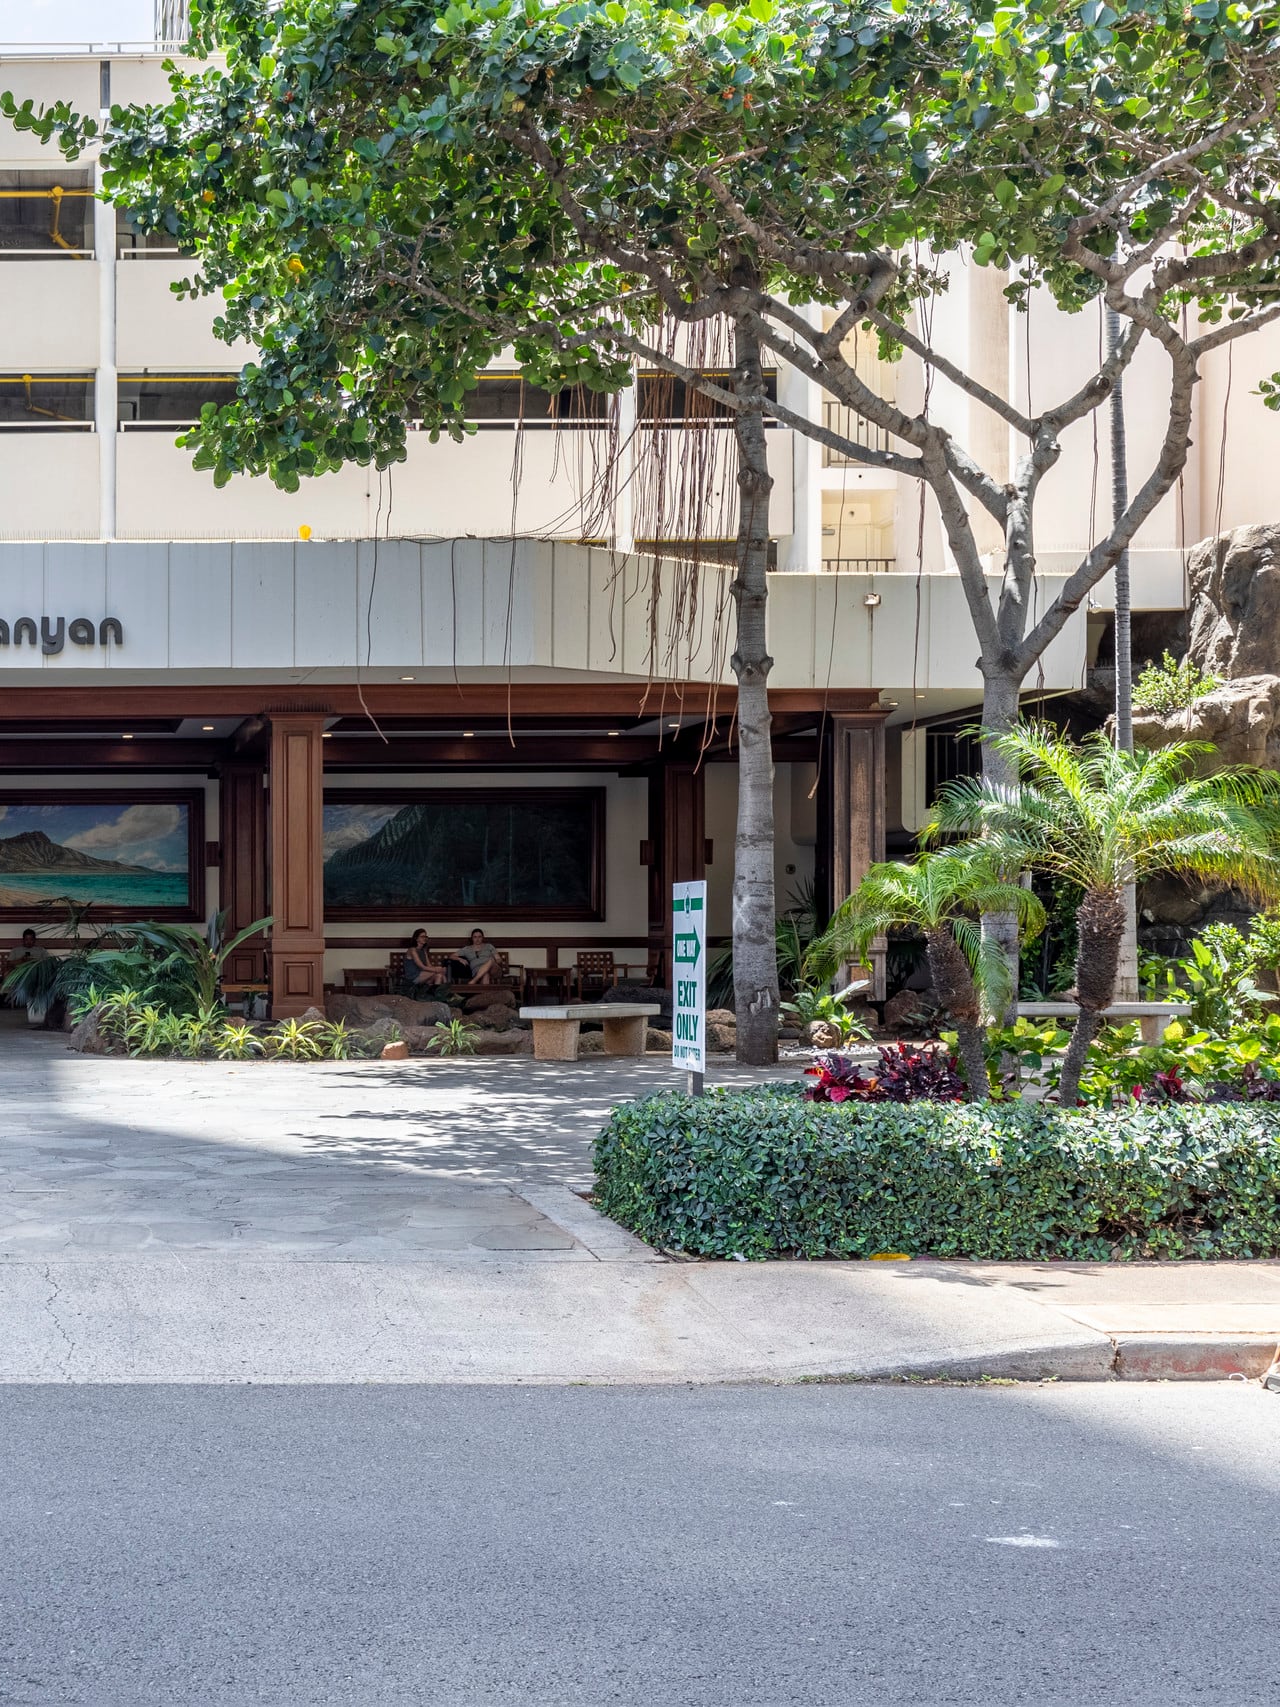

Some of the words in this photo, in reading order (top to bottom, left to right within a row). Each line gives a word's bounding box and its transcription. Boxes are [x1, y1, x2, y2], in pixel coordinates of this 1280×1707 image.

[677, 980, 697, 1008] EXIT
[676, 1013, 699, 1042] ONLY
[674, 1045, 679, 1057] DO
[680, 1045, 688, 1059] NOT
